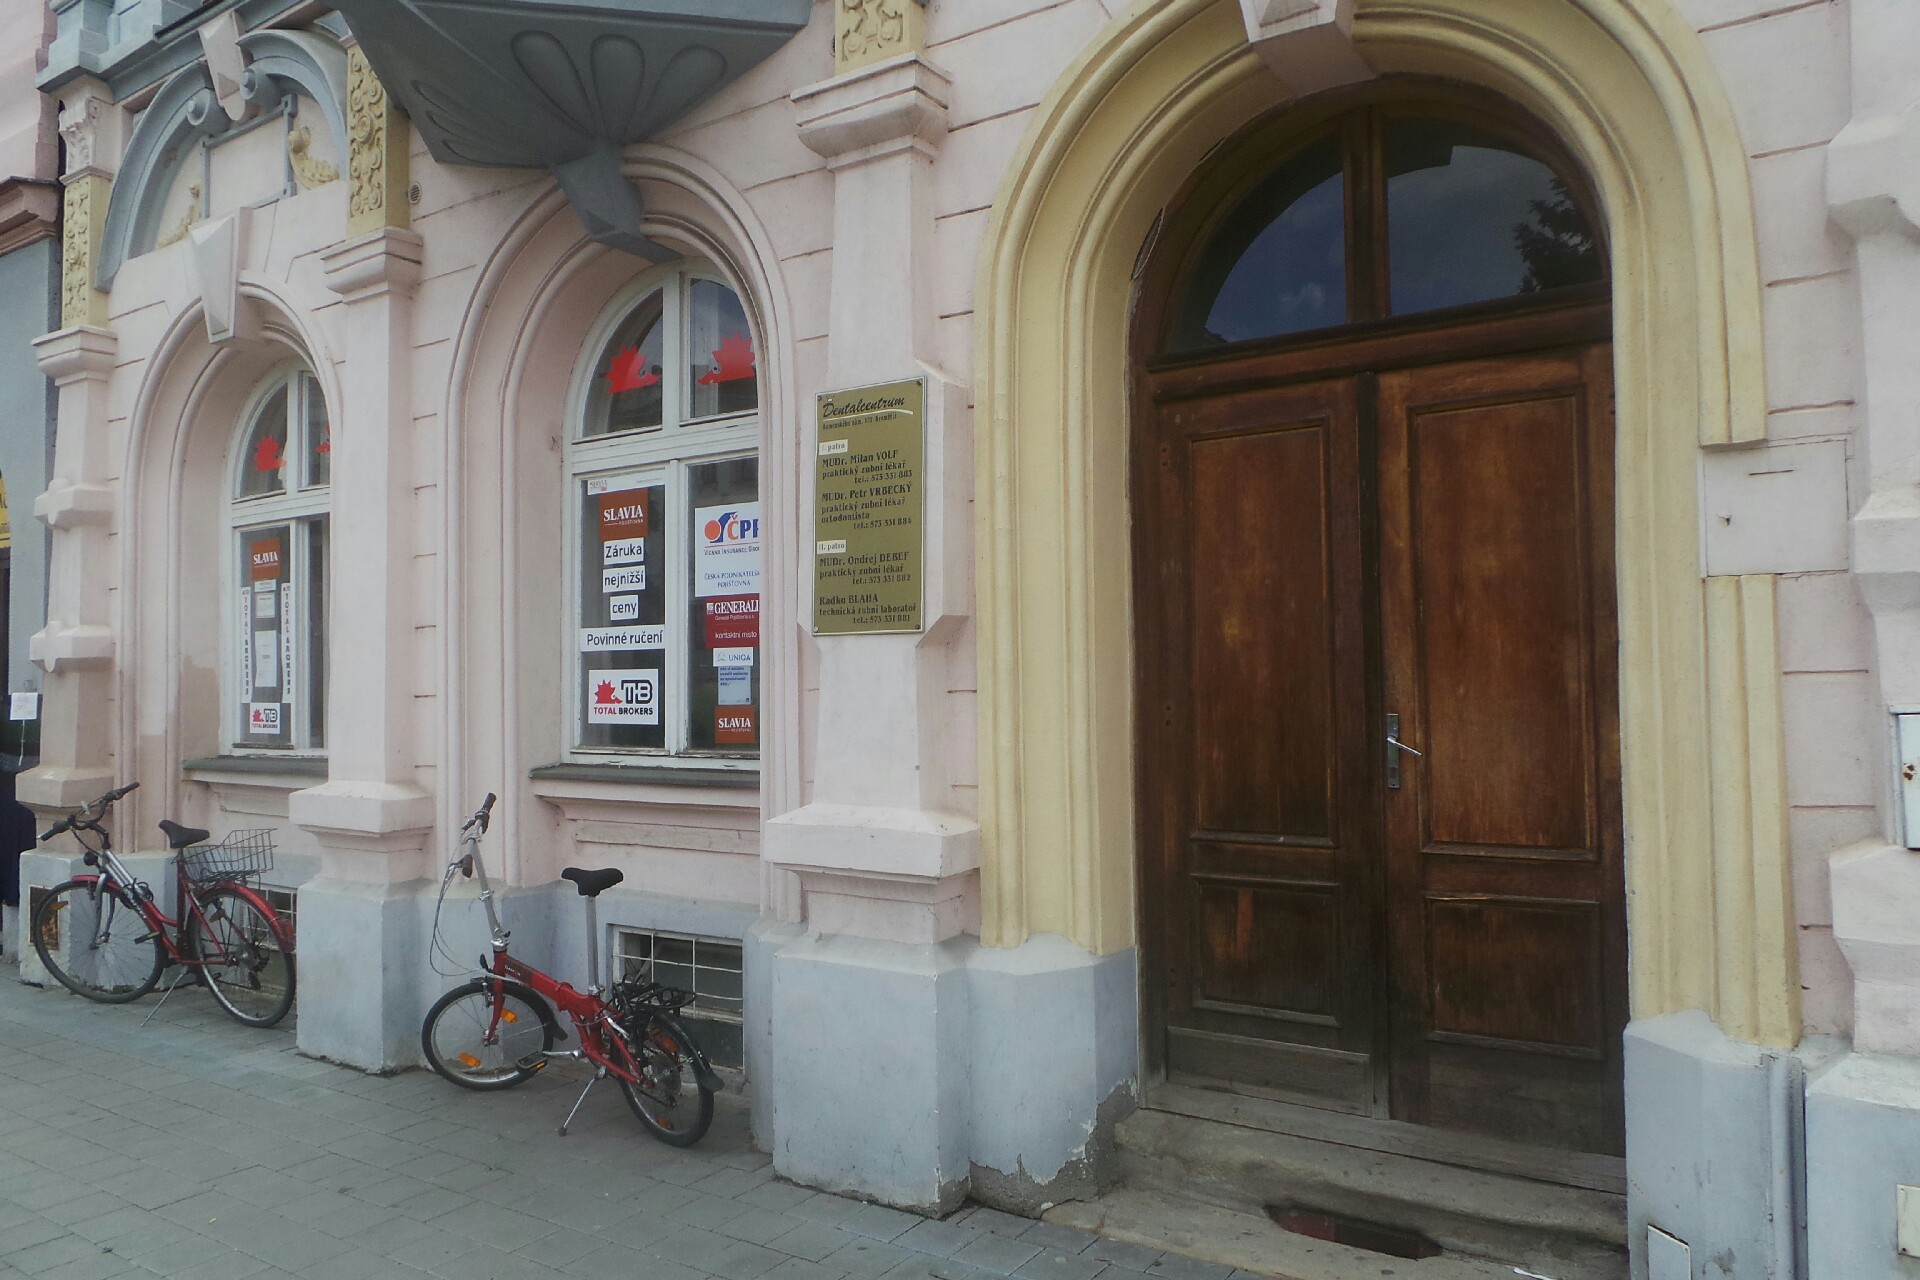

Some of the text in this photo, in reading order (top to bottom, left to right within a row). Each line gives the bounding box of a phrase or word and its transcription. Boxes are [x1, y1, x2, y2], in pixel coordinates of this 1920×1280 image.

[823, 397, 905, 417] Dentalcentrum
[828, 442, 845, 452] patro
[822, 450, 898, 467] MUDr. Milan VOLF
[822, 460, 906, 480] praktický zubní lékař
[854, 476, 868, 484] tel.:
[822, 482, 912, 502] MUDr. Petr VRBECKÝ
[822, 496, 906, 514] praktický zubní lékař
[604, 504, 643, 522] SLAVIA
[822, 512, 870, 523] ortodontista
[606, 544, 642, 558] Záruka
[828, 542, 845, 551] patro
[254, 552, 278, 564] SLAVIA
[820, 557, 845, 566] MUDr.
[848, 553, 877, 565] Ondřej
[820, 563, 904, 580] praktický zubní lékař
[604, 570, 643, 588] nejnižší
[714, 600, 759, 614] GENERALI
[820, 596, 846, 605] Radko
[612, 602, 637, 615] ceny
[820, 603, 916, 616] technická zubní laboratoř
[587, 630, 664, 646] Povinné ručení
[621, 680, 652, 704] TB
[718, 718, 751, 728] SLAVIA
